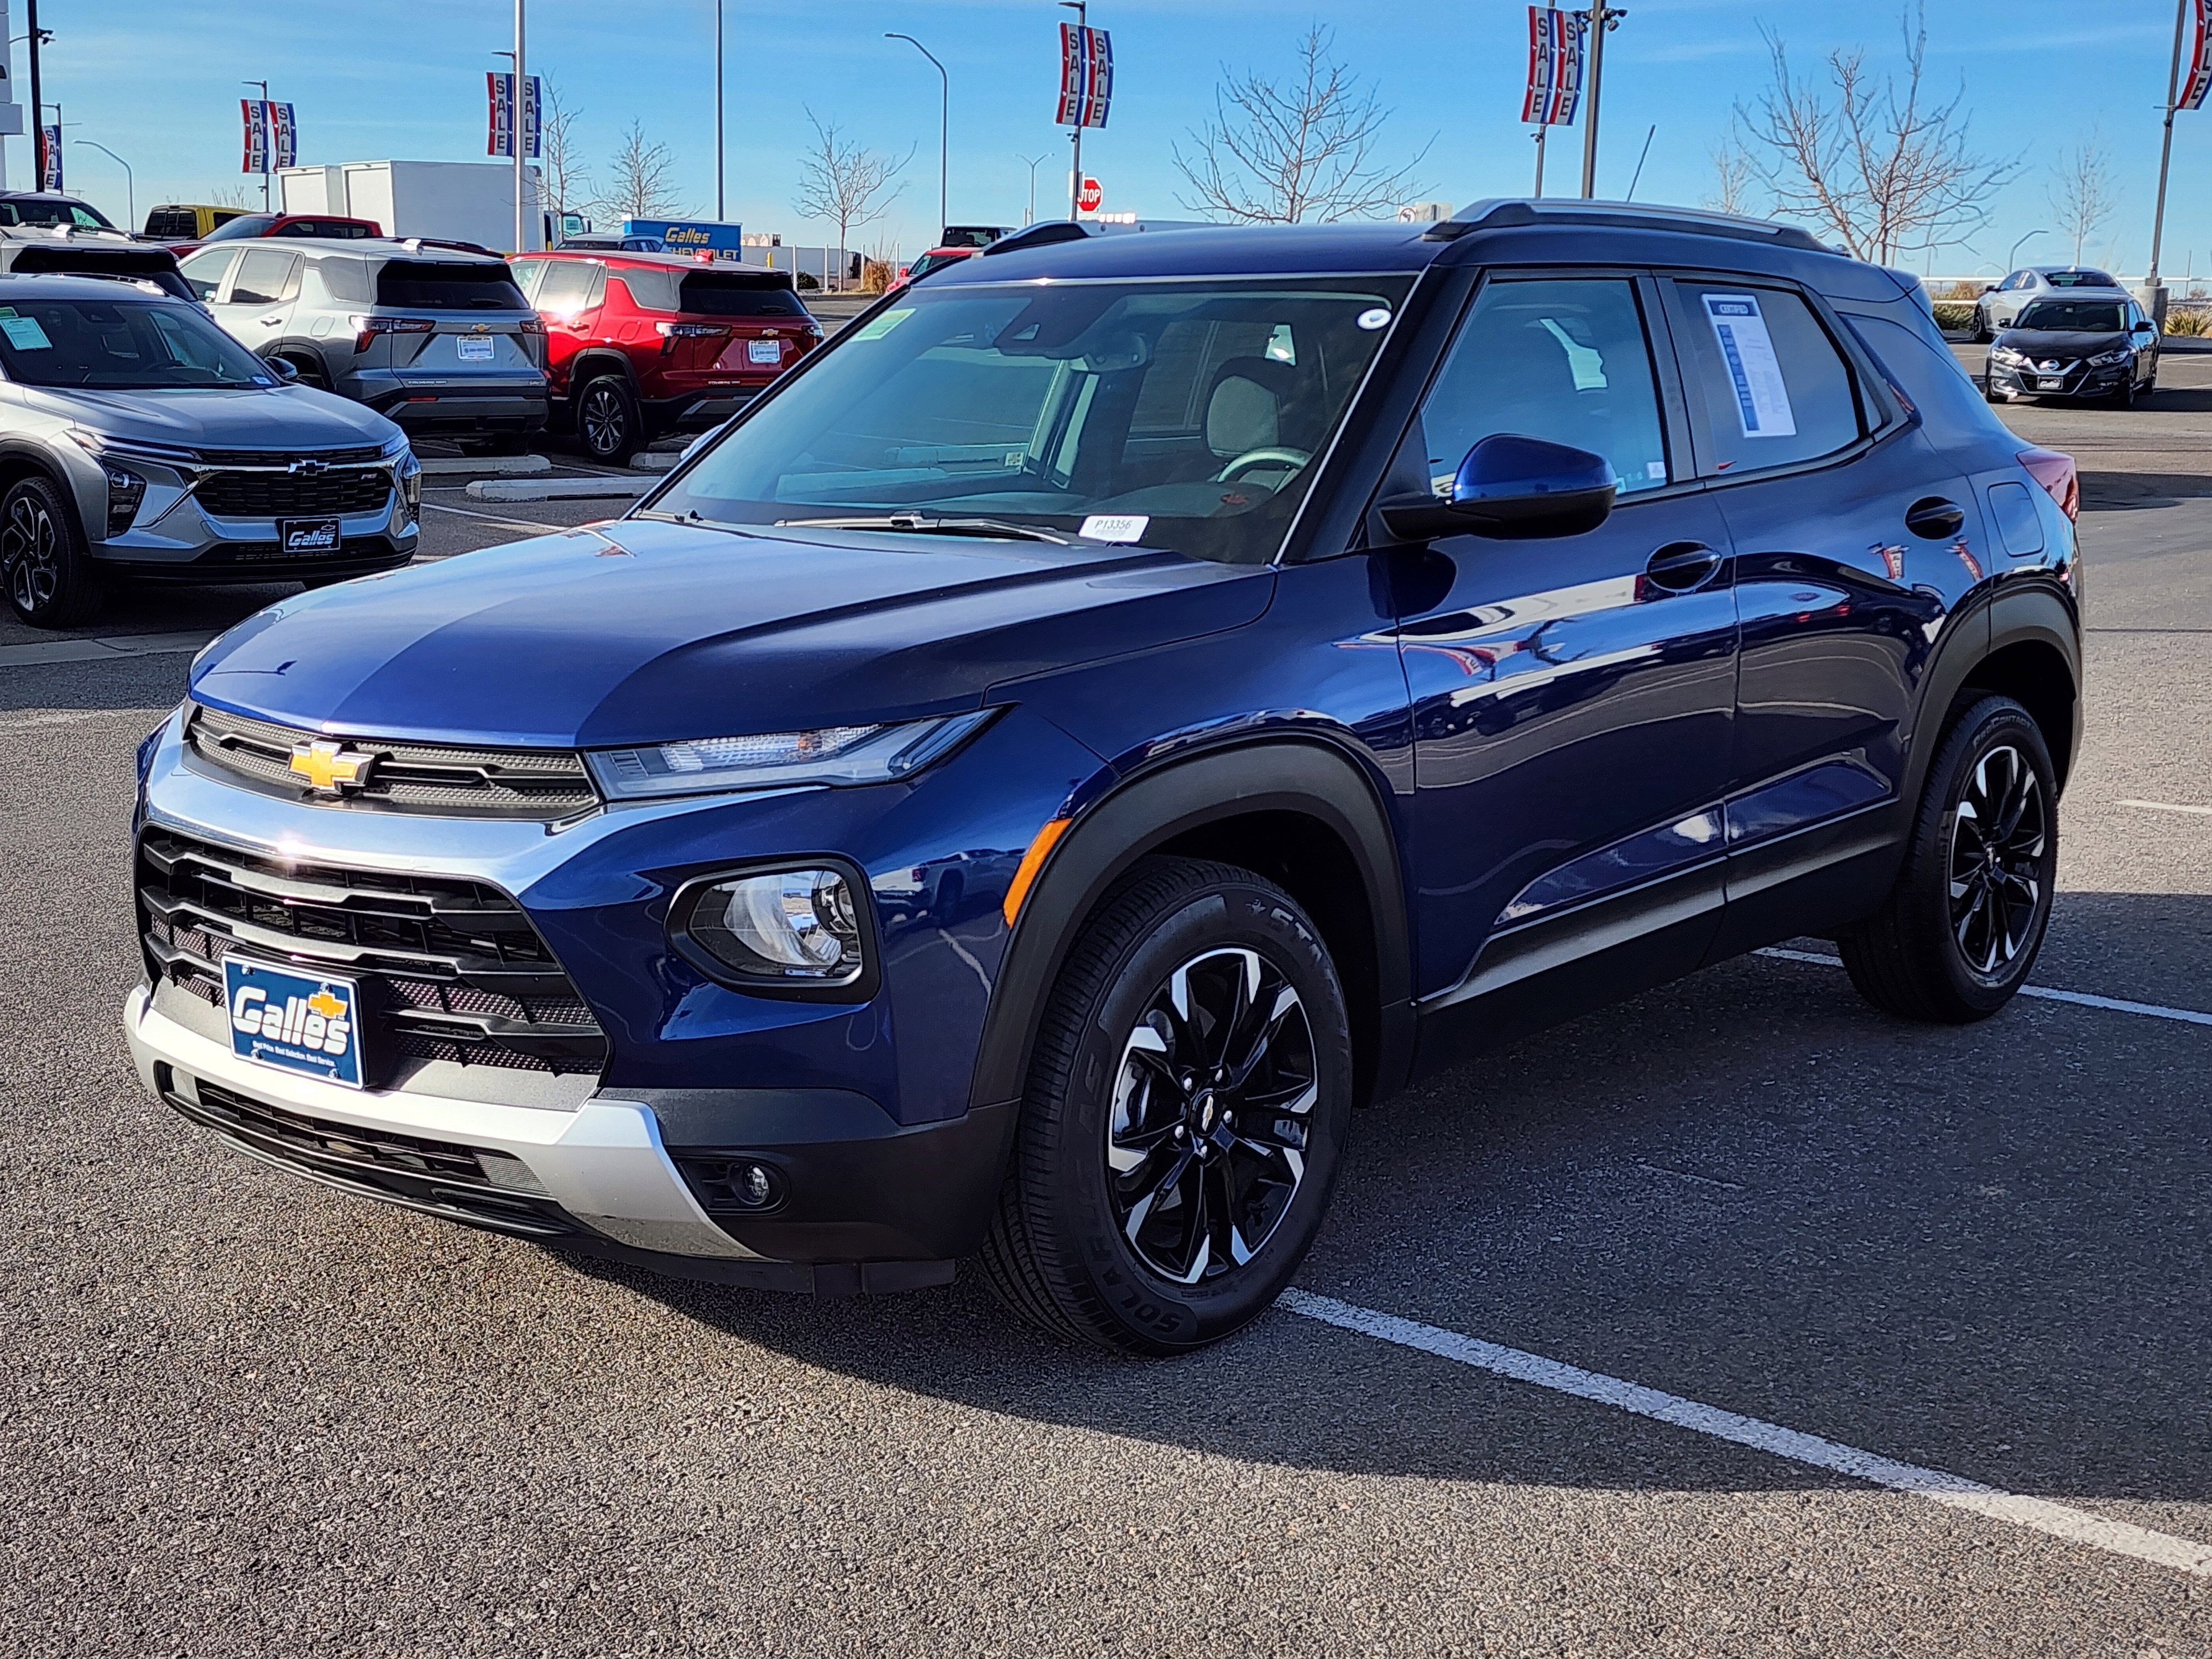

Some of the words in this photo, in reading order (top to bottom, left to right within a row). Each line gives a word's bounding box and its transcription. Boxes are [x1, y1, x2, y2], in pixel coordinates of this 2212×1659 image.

[1066, 32, 1080, 116] SALE
[1092, 36, 1107, 119] SALE
[1532, 17, 1548, 113] SALE
[1559, 22, 1577, 116] SALE
[249, 106, 262, 168] SALE
[278, 107, 290, 168] SALE
[495, 79, 507, 149] SALE
[525, 82, 535, 152] SALE
[45, 130, 56, 185] SALE
[665, 227, 711, 244] Galles
[669, 247, 739, 260] HEVLET
[288, 530, 336, 546] Galles
[1094, 520, 1133, 530] P13356
[232, 985, 351, 1055] Galles
